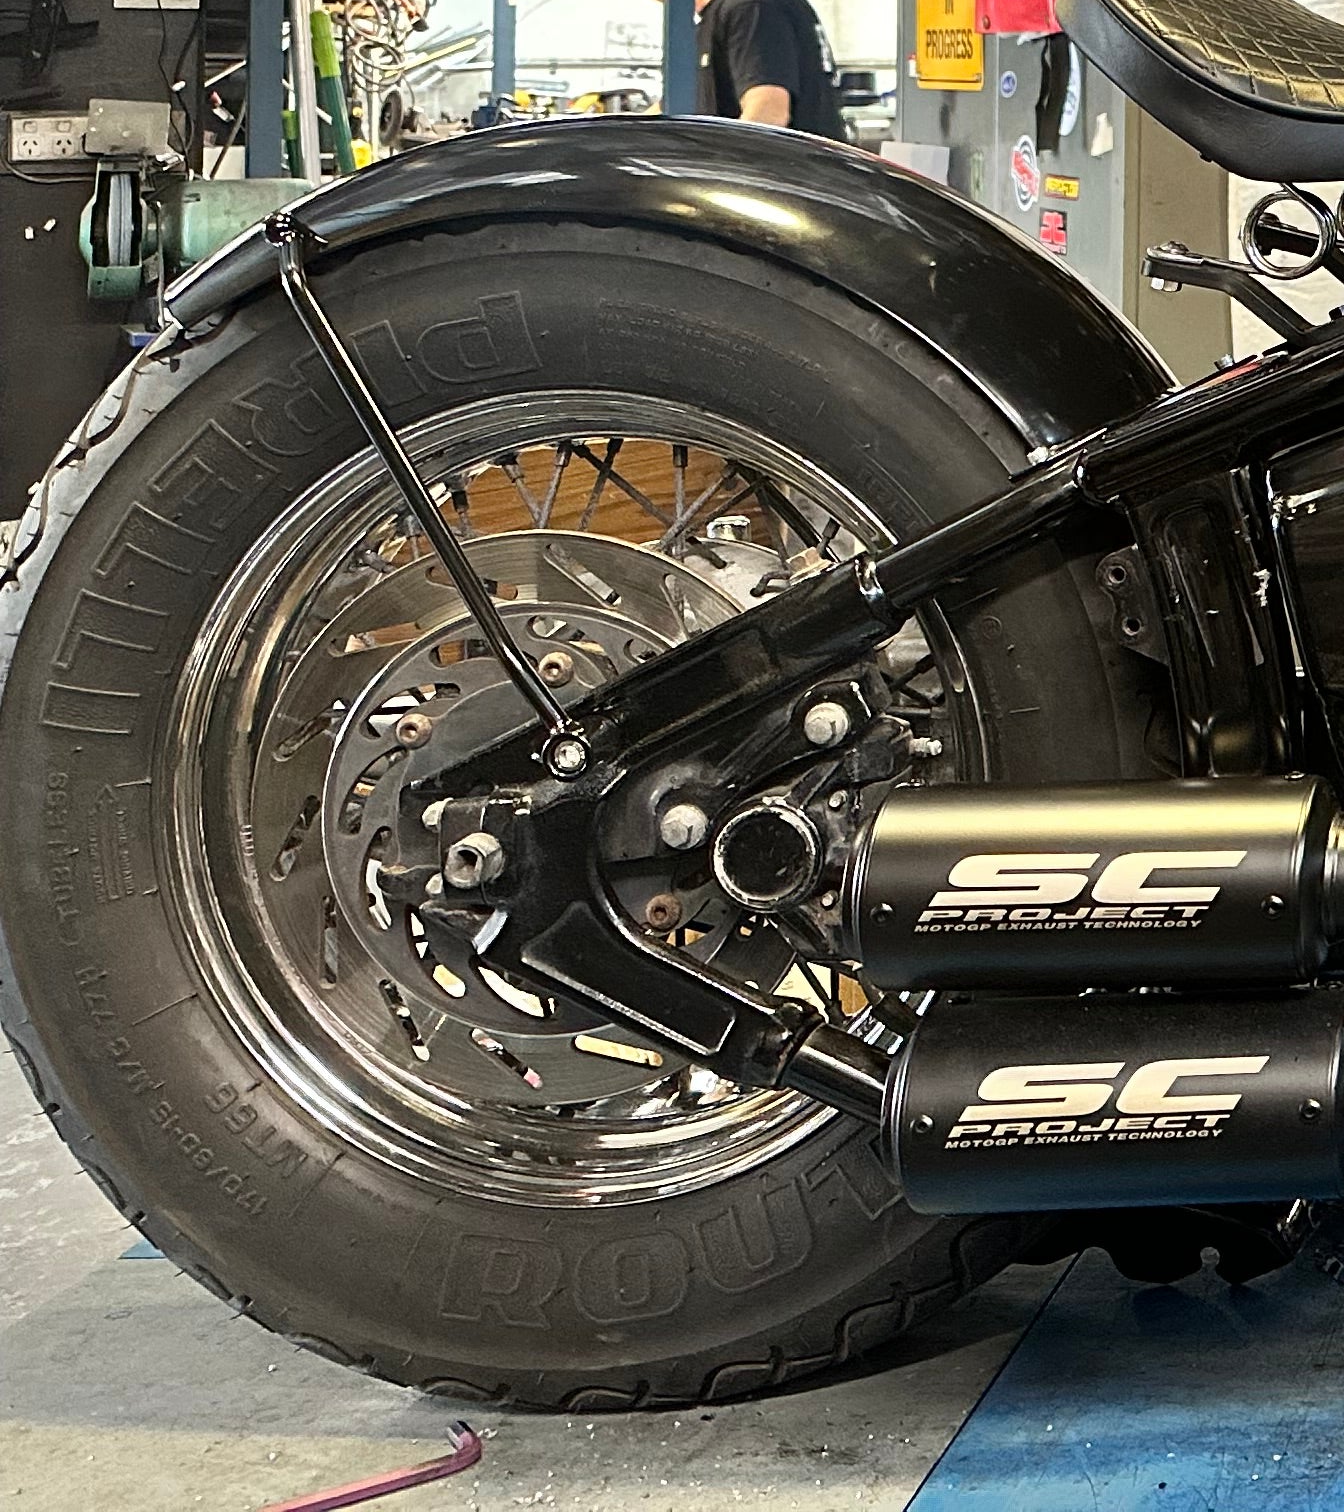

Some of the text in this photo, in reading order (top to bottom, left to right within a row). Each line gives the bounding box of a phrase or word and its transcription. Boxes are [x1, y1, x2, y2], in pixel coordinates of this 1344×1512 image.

[925, 28, 973, 61] PROGRESS
[40, 291, 543, 735] PIRELLI
[929, 850, 1248, 907] SC
[914, 918, 1204, 933] MOTOGP EXHAUST TECHNOLOGY
[918, 905, 1210, 923] PROJECT
[957, 1055, 1271, 1122] SC
[204, 1080, 309, 1181] MT66
[944, 1127, 1226, 1150] MOTOGP EXHAUST TECHNOLOGY
[947, 1113, 1232, 1139] PROJECT
